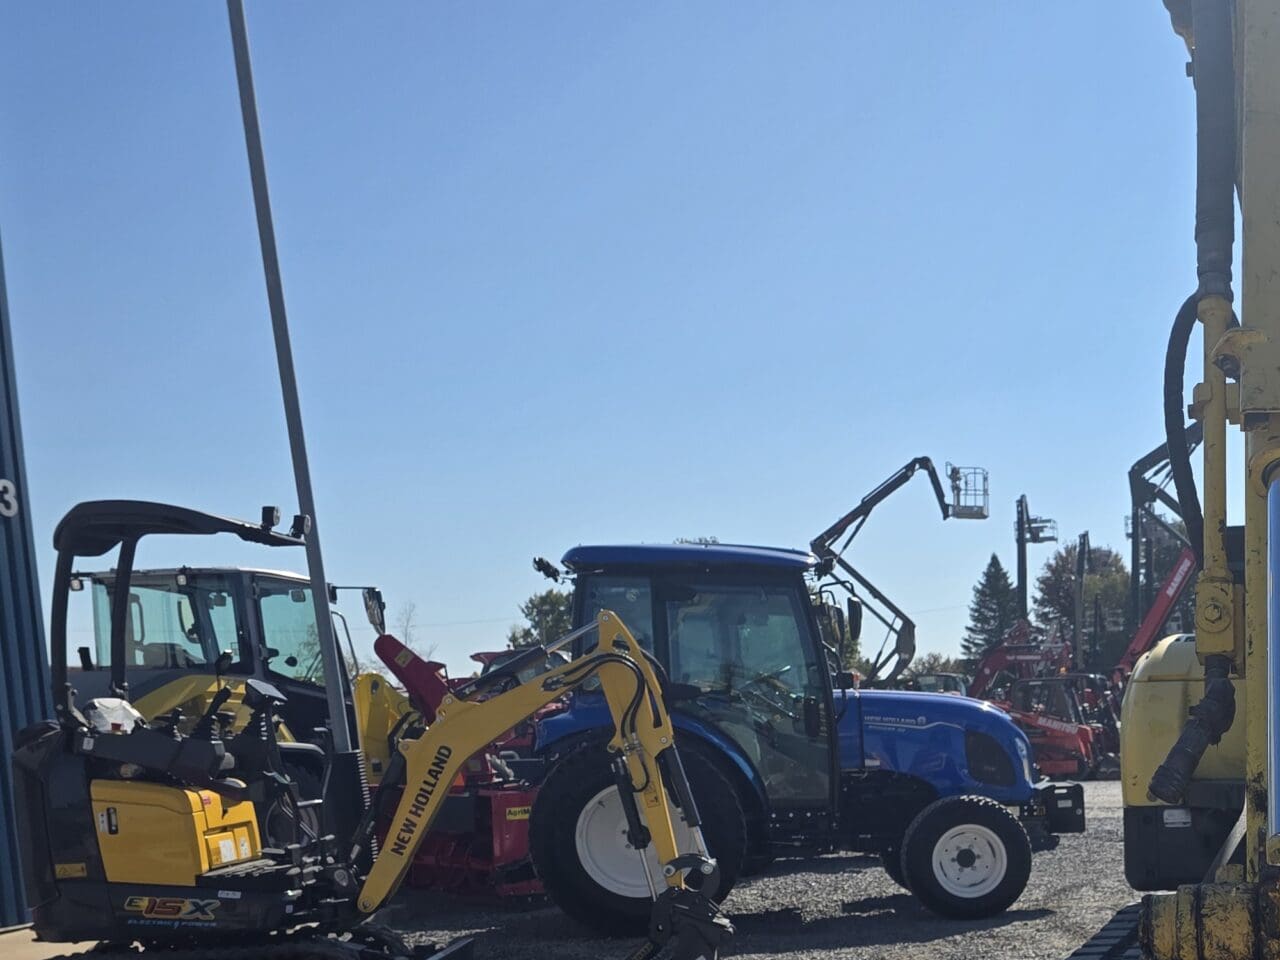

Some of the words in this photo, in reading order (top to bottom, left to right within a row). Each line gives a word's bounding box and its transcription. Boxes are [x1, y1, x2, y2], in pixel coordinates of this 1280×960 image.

[0, 479, 19, 517] 3
[391, 818, 418, 856] NEW
[409, 745, 453, 818] HOLLAND
[124, 896, 220, 919] E15X
